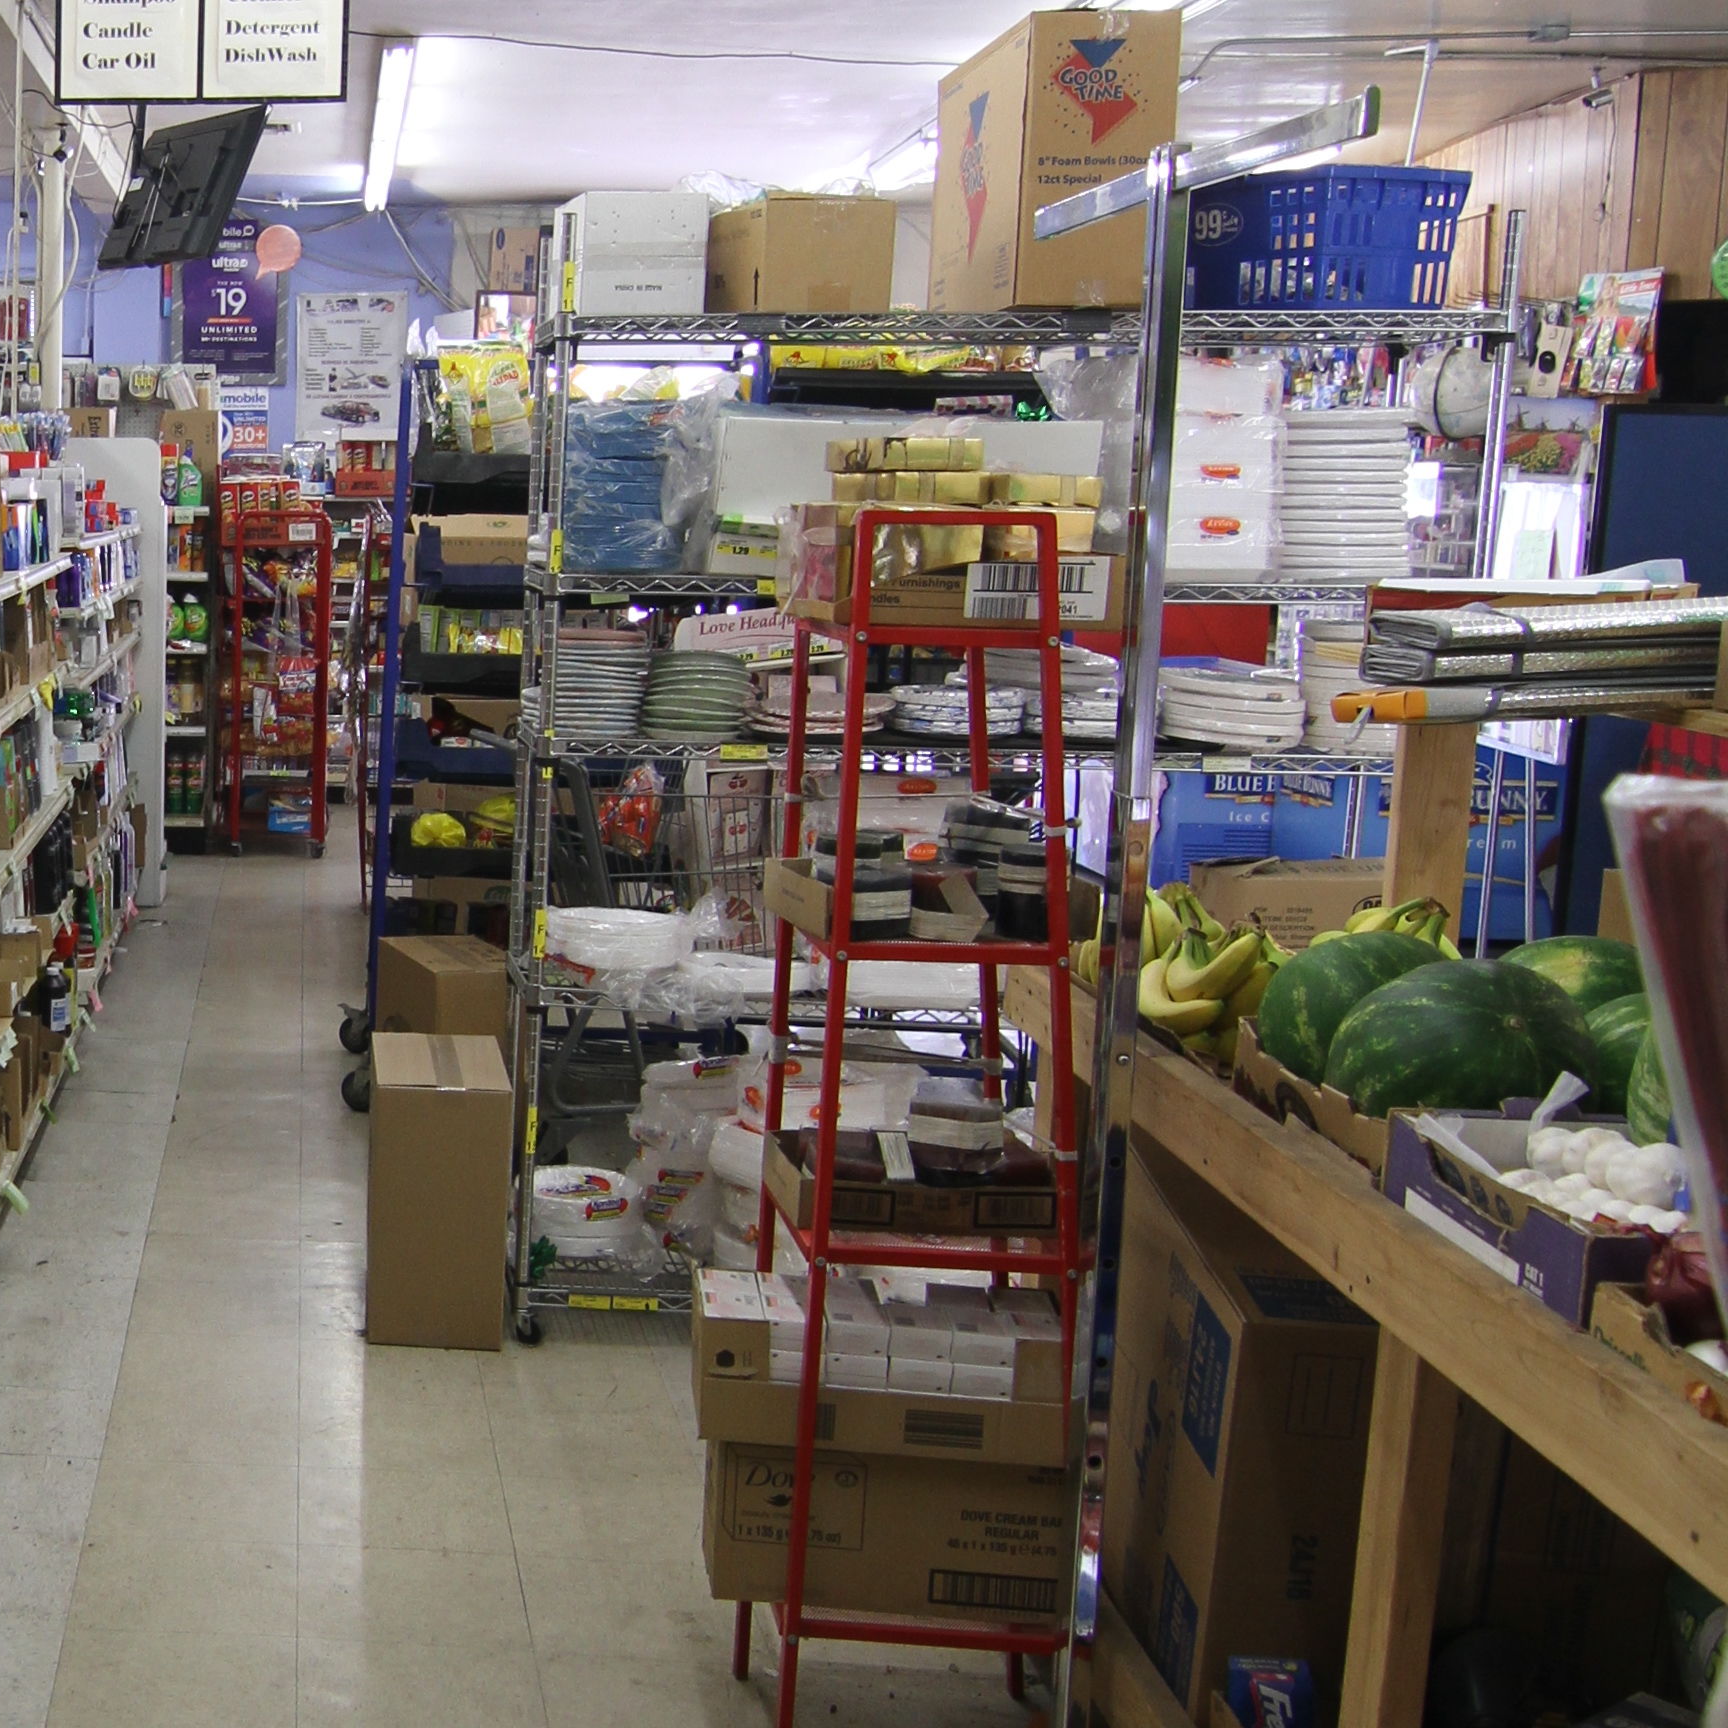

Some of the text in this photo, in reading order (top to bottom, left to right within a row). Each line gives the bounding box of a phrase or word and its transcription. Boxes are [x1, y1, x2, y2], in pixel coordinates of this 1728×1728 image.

[83, 22, 153, 39] Candle
[225, 20, 320, 37] Detergent
[82, 52, 156, 70] Car Oil
[224, 47, 317, 64] DishWash
[1058, 68, 1118, 86] GOOD
[1075, 84, 1124, 101] TIME
[1052, 156, 1082, 167] Foam
[1084, 156, 1116, 167] Bowls
[1038, 174, 1102, 186] 12ct Special
[566, 278, 573, 287] F
[201, 326, 258, 334] UNLIMITED
[234, 427, 265, 442] 30+
[554, 546, 561, 555] F
[700, 619, 736, 636] Love
[1214, 773, 1262, 791] BLUE
[1303, 776, 1332, 798] BUNNY
[1229, 811, 1252, 823] Ice
[1467, 835, 1517, 851] rem
[960, 1509, 992, 1524] DOVE
[994, 1511, 1037, 1526] CREAM
[984, 1526, 1039, 1541] REGULAR
